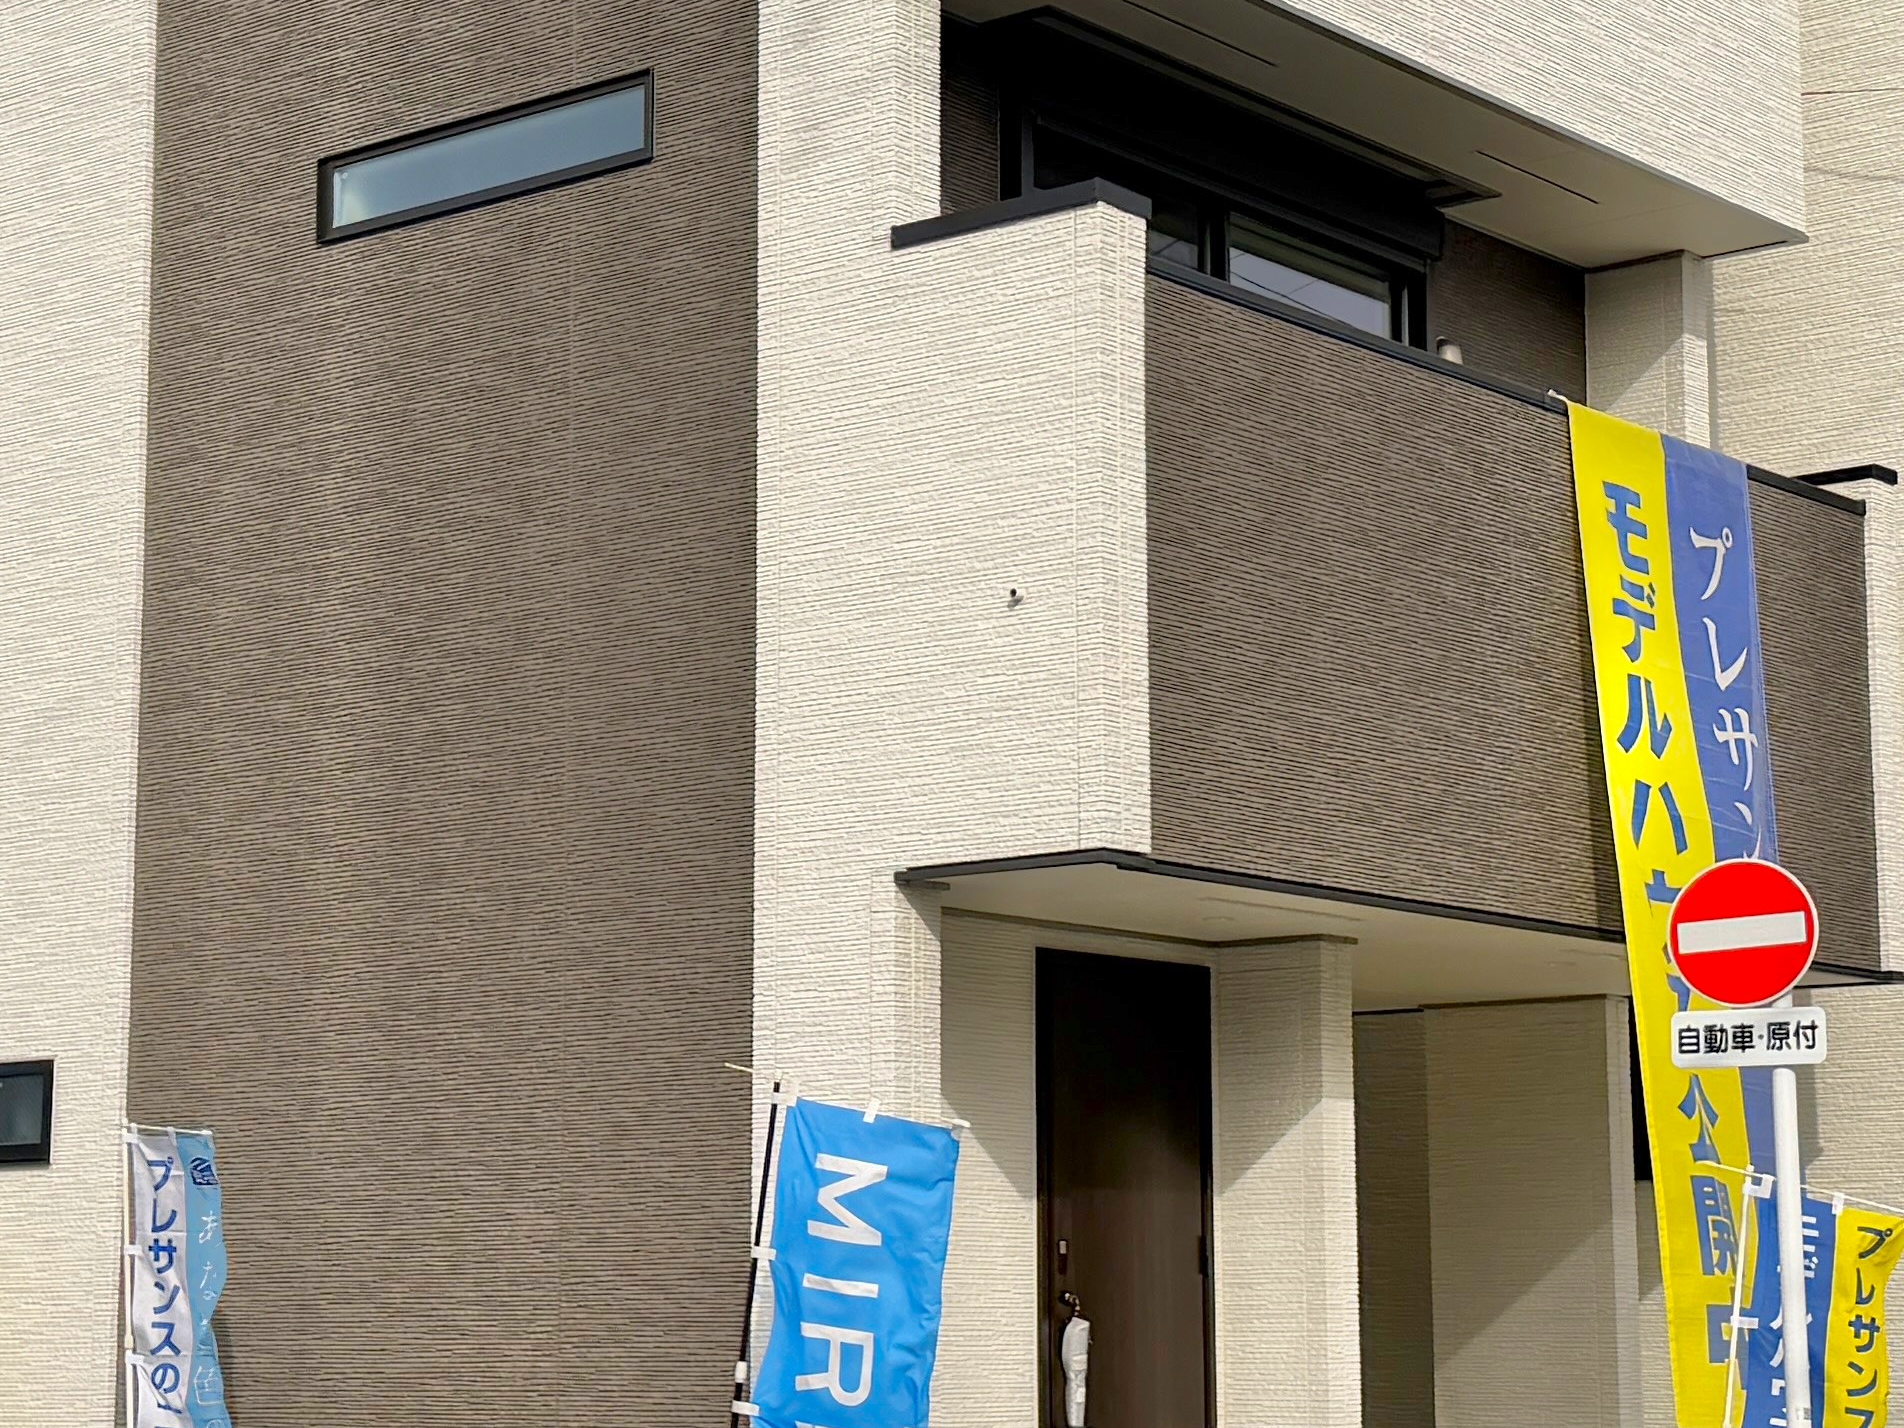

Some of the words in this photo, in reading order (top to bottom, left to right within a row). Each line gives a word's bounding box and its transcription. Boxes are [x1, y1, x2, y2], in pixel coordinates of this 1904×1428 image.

[1678, 1019, 1818, 1054] 自動車・原付
